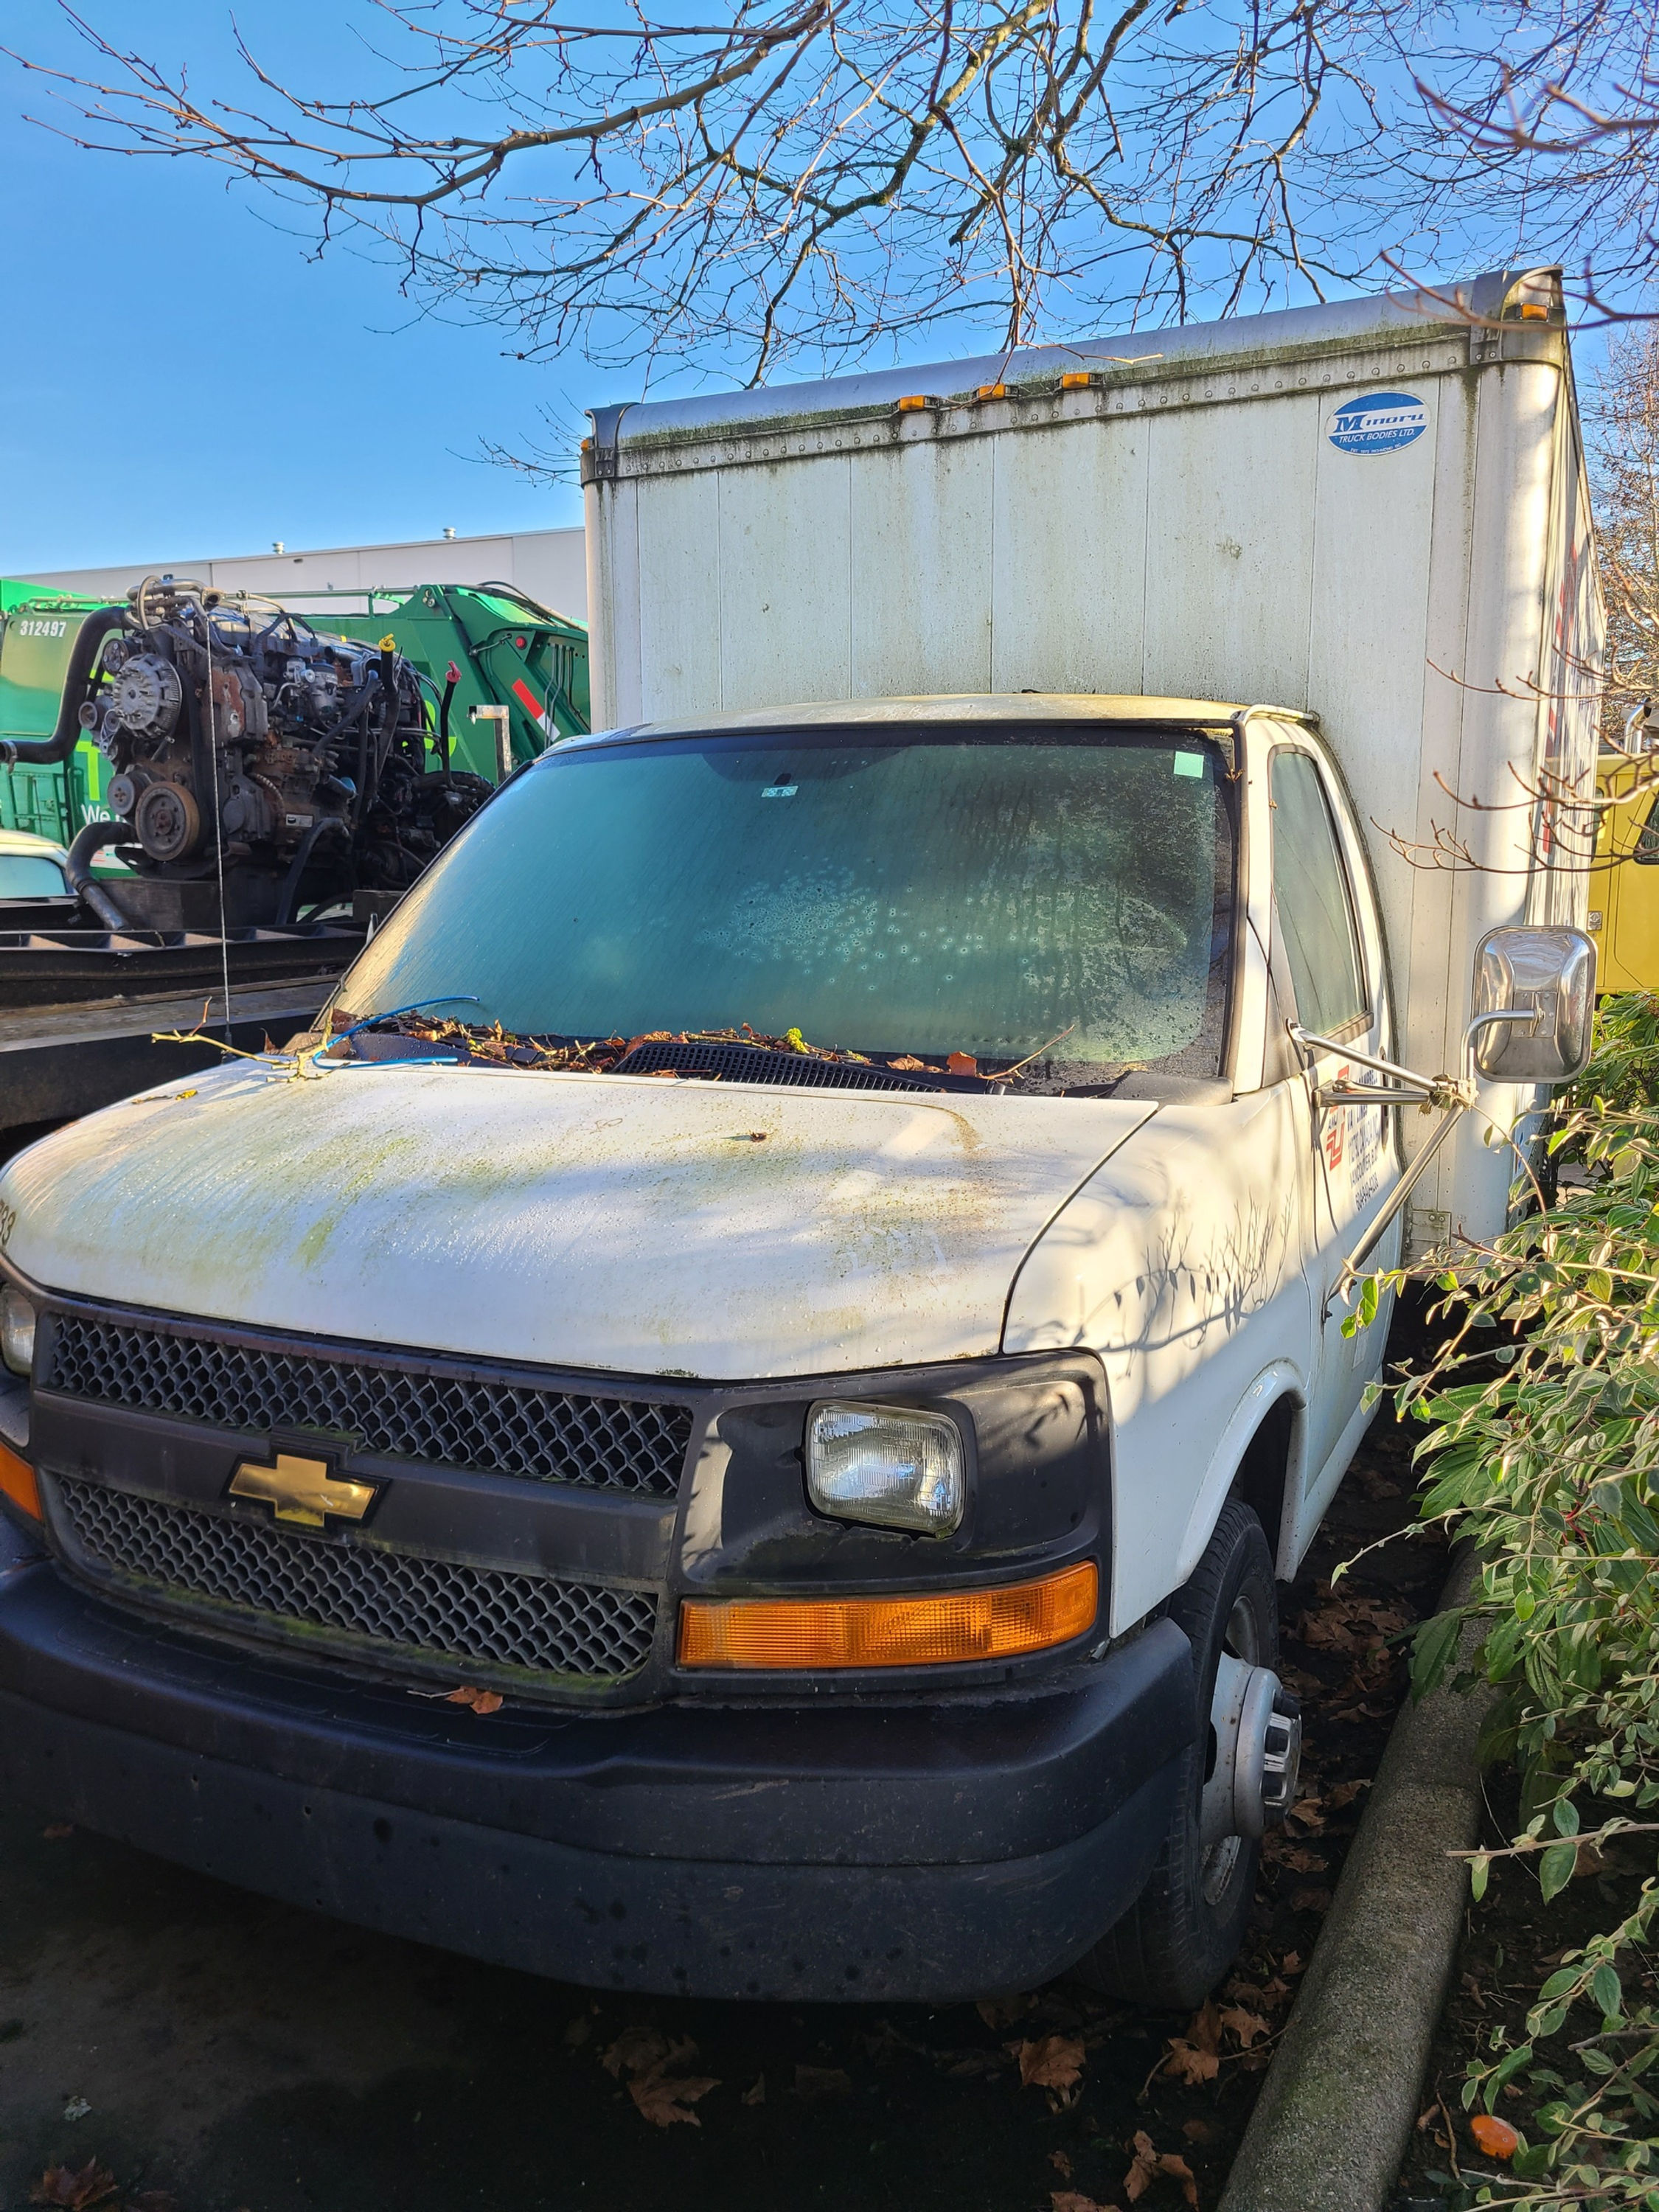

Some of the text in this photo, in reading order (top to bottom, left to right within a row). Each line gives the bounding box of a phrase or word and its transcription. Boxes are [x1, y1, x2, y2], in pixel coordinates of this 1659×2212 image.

[1333, 413, 1425, 434] Minoru
[1338, 428, 1415, 444] TRUCK BODIES LTD.
[19, 620, 66, 638] 312497
